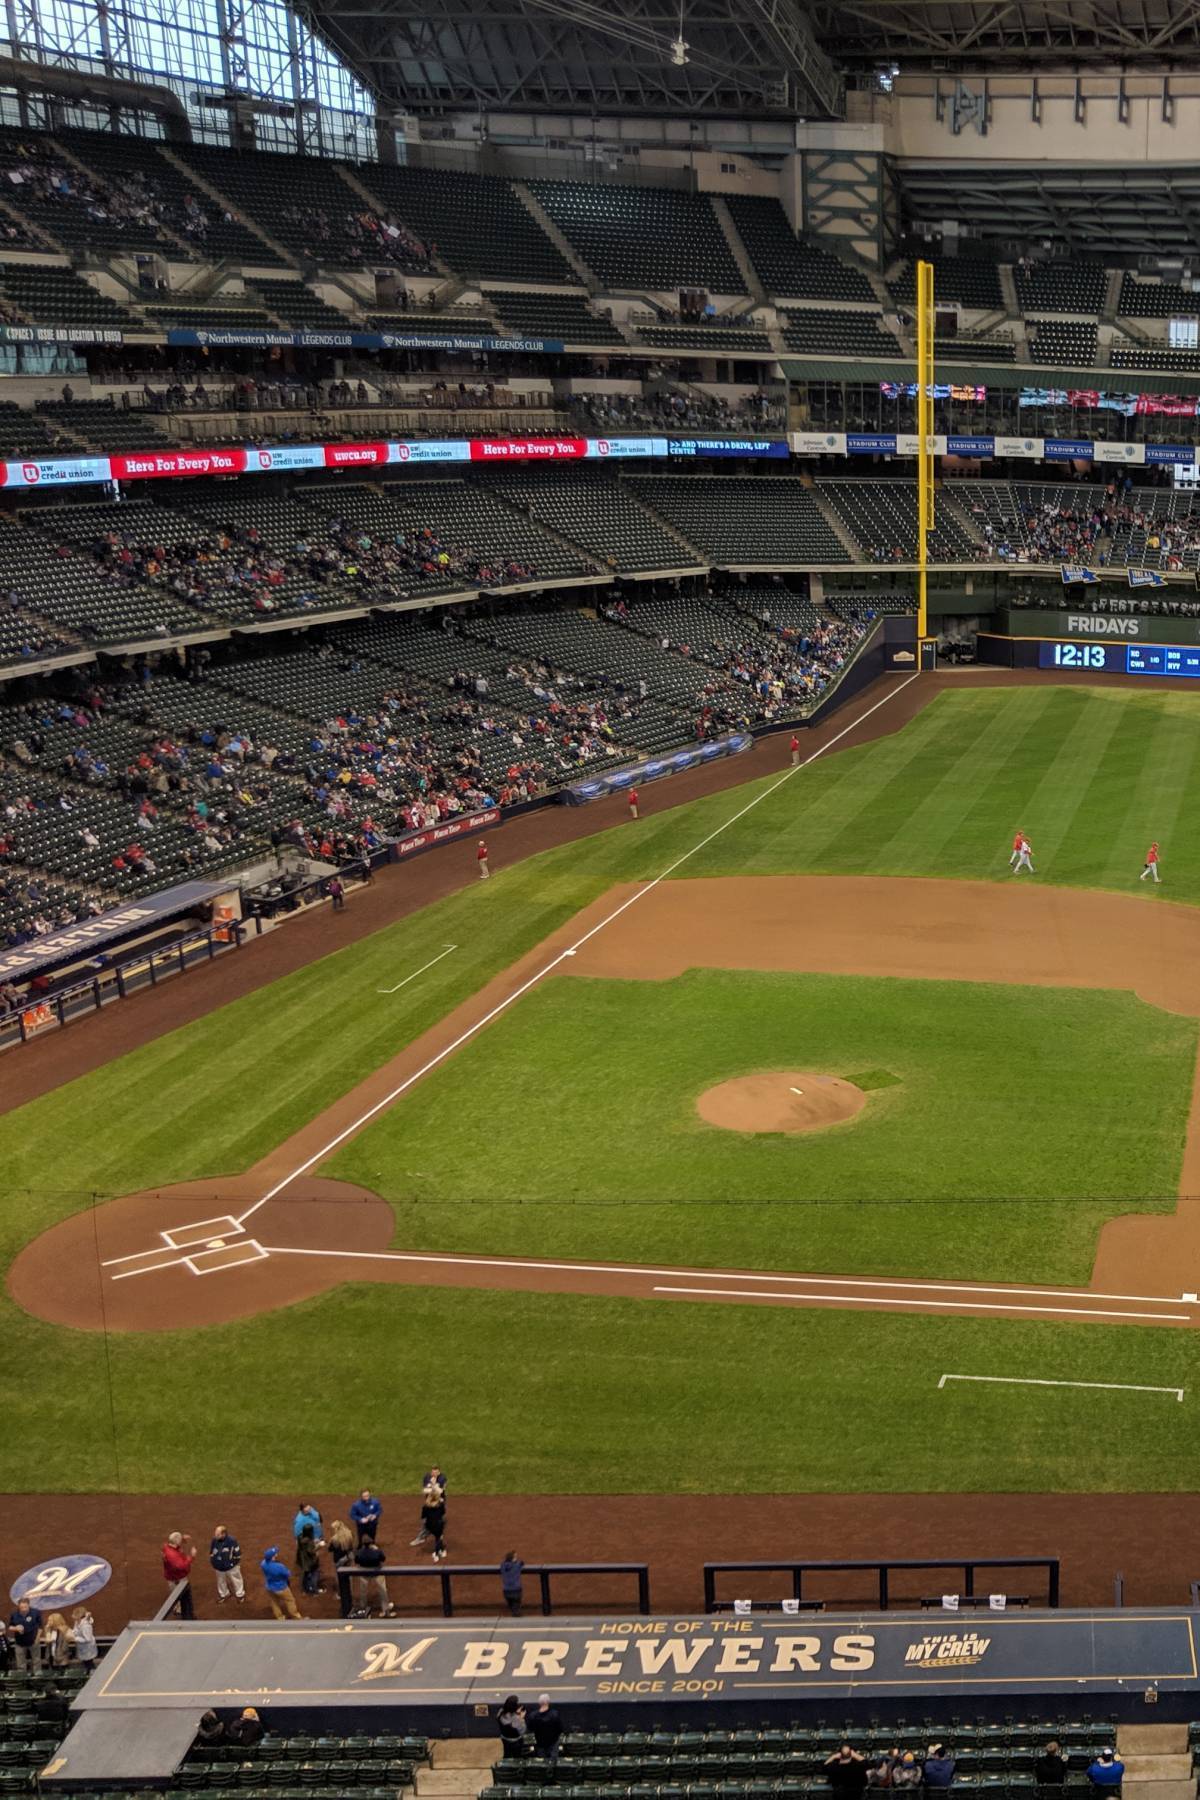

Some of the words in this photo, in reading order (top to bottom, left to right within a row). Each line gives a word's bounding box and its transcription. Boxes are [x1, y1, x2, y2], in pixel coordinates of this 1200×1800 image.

[56, 329, 68, 341] AND
[69, 329, 95, 341] LOCATION
[208, 333, 265, 345] Northwestern
[266, 334, 294, 345] Mutual
[302, 335, 333, 345] LEGENDS
[334, 336, 352, 345] CLUB
[395, 336, 452, 348] Northwestern
[454, 339, 483, 349] Mutual
[491, 340, 524, 350] LEGENDS
[525, 341, 544, 350] CLUB
[483, 444, 508, 454] Here
[509, 444, 526, 454] For
[527, 444, 556, 456] Every
[557, 443, 576, 453] You.
[698, 441, 725, 450] THERE'S
[334, 450, 377, 462] uwcu.org
[126, 460, 154, 473] Here
[157, 459, 175, 471] For
[178, 457, 208, 471] Every
[210, 455, 235, 467] You.
[41, 470, 67, 479] credit
[68, 470, 94, 479] union
[1068, 616, 1139, 634] FRIDAYS
[1055, 644, 1106, 667] 12:13
[601, 1623, 666, 1634] HOME
[674, 1622, 703, 1633] OF
[711, 1621, 753, 1632] THE
[922, 1635, 956, 1644] THIS
[962, 1633, 977, 1641] IS
[453, 1635, 875, 1677] BREWERS
[905, 1643, 938, 1661] MY
[938, 1638, 991, 1657] CREW
[597, 1681, 663, 1693] SINCE
[672, 1679, 724, 1693] 2001
